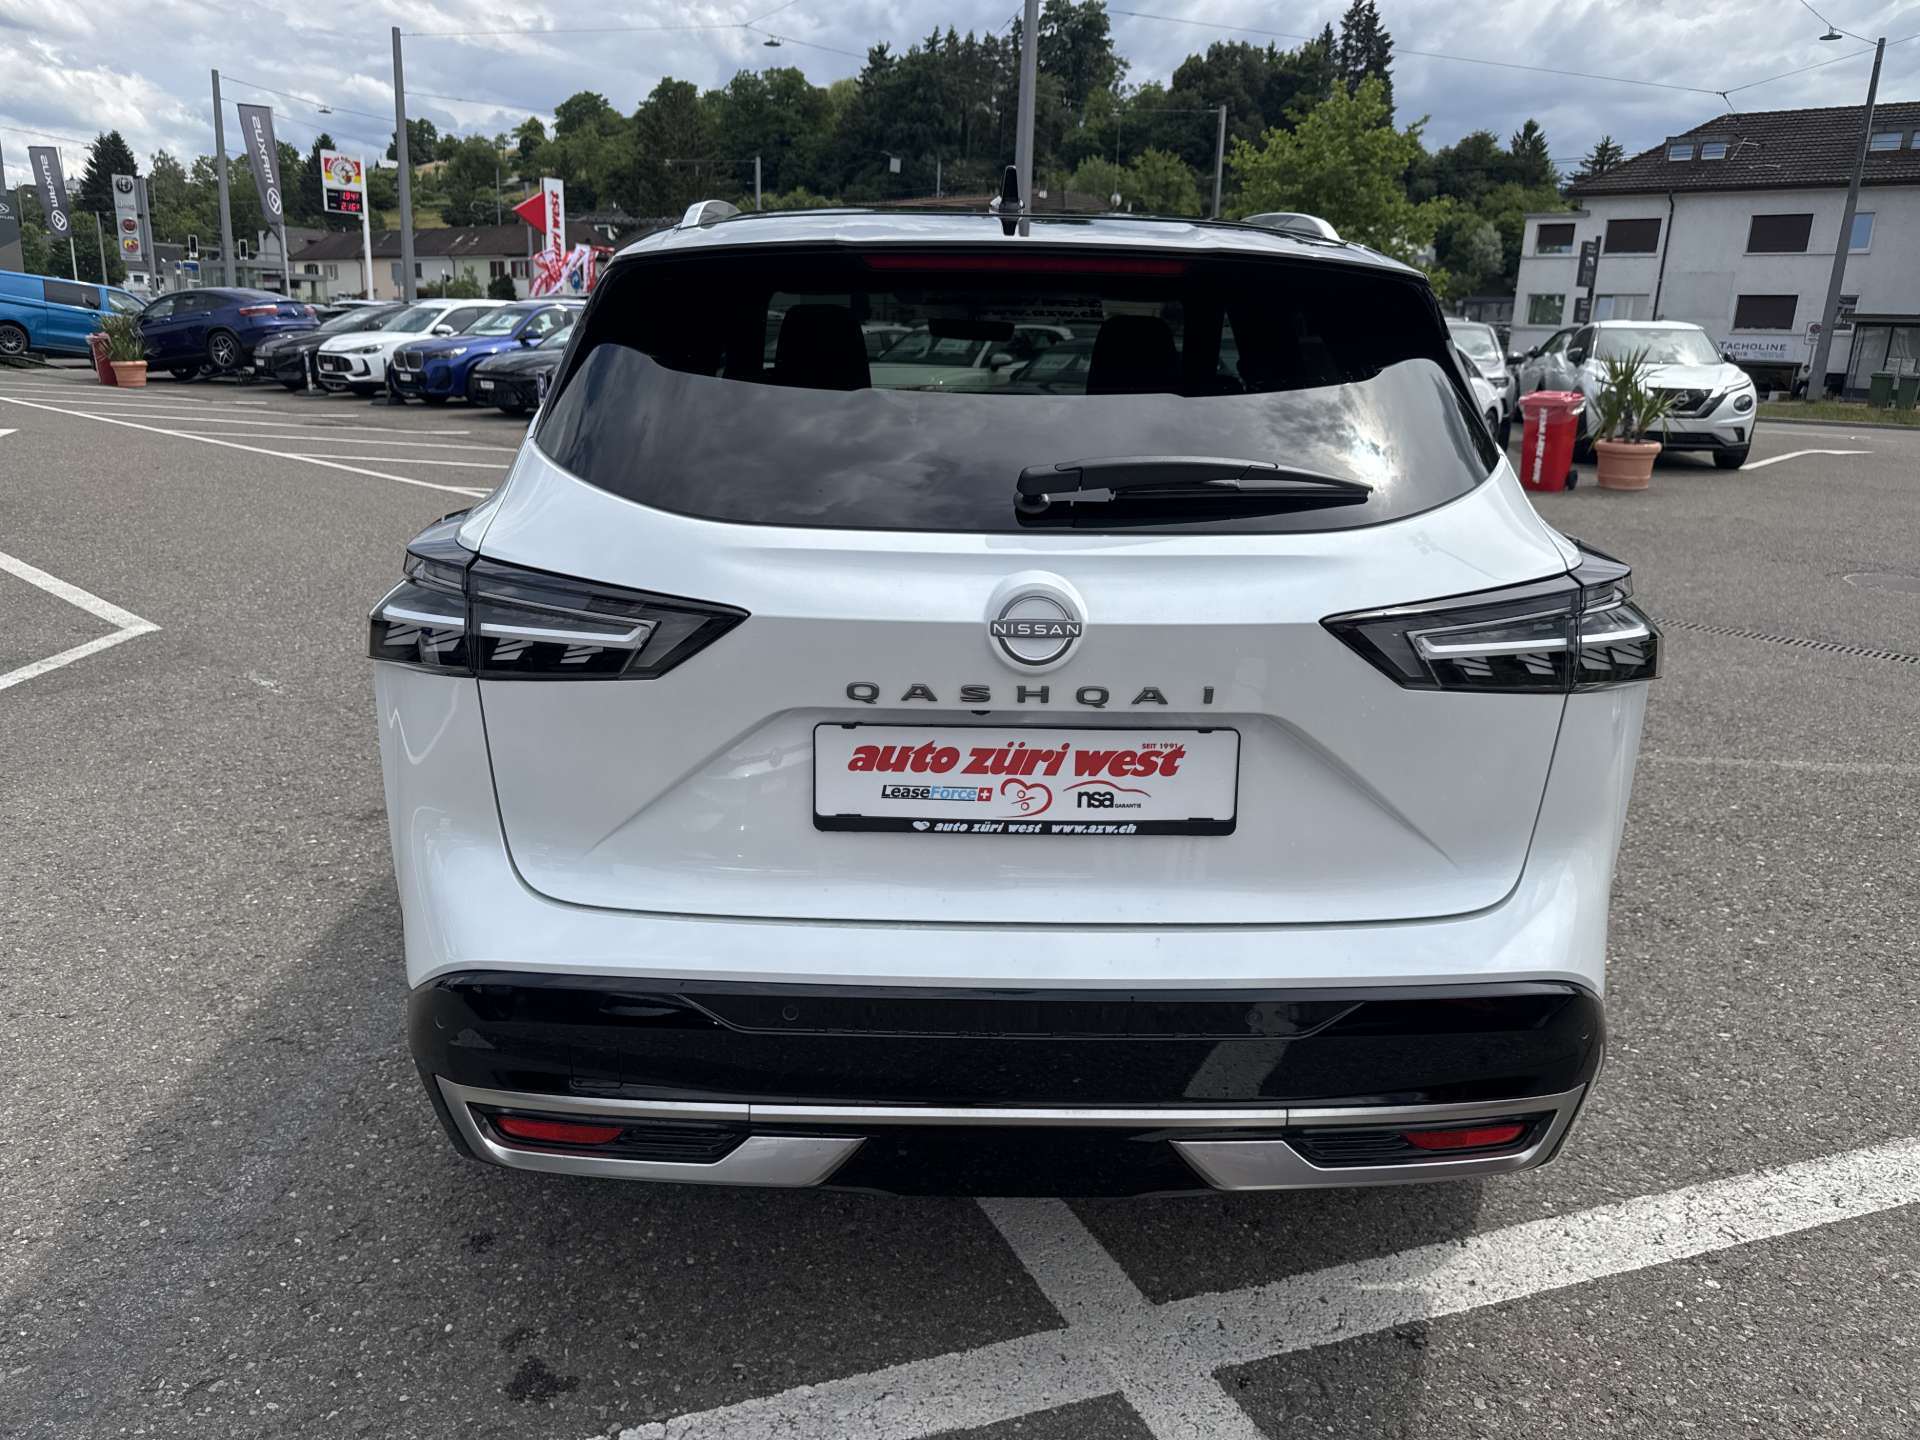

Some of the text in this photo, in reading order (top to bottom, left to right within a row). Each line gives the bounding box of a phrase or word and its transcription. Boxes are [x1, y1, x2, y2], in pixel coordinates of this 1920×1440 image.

[993, 623, 1080, 635] NISSAN
[846, 681, 1214, 708] QASHQAI
[848, 740, 1186, 777] auto züri west
[881, 784, 977, 800] LeaseForce
[1077, 791, 1115, 809] nsa
[934, 822, 967, 832] auto
[971, 822, 1002, 833] züri
[1008, 823, 1041, 833] west
